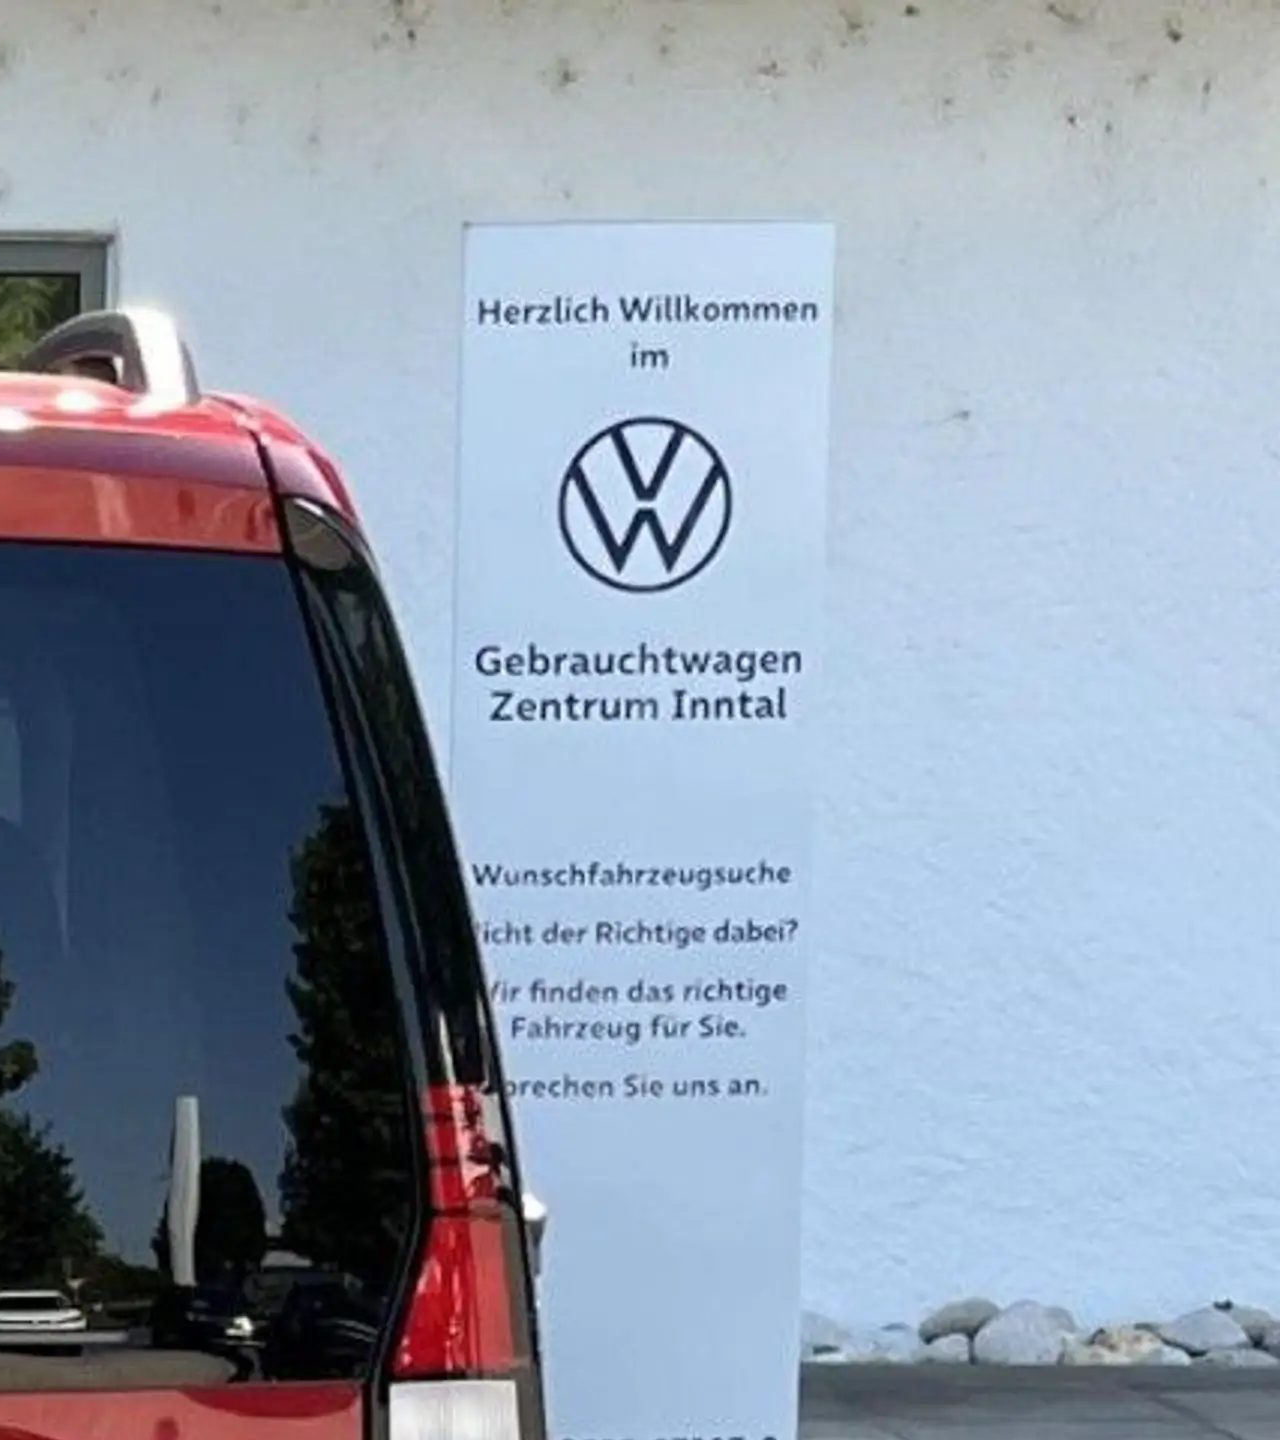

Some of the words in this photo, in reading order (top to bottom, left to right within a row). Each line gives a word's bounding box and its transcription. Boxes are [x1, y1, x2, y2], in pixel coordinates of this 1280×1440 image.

[477, 298, 611, 326] Herzlich
[619, 296, 819, 324] Willkommen
[630, 343, 670, 370] im
[558, 416, 733, 594] VW
[475, 643, 803, 683] Gebrauchtwagen
[489, 690, 659, 722] Zentrum
[671, 687, 788, 721] Inntal
[472, 859, 792, 892] Wunschfahrzeugsuche
[477, 921, 533, 946] icht
[540, 920, 588, 946] der
[595, 920, 706, 949] Richtige
[713, 917, 799, 944] dabei?
[529, 977, 619, 1005] finden
[625, 978, 675, 1004] das
[682, 977, 788, 1007] richtige
[510, 1014, 641, 1044] Fahrzeug
[650, 1013, 691, 1040] für
[698, 1012, 748, 1039] Sie.
[504, 1073, 615, 1099] prechen
[623, 1073, 665, 1098] Sie
[672, 1076, 721, 1097] uns
[727, 1077, 769, 1097] an.
